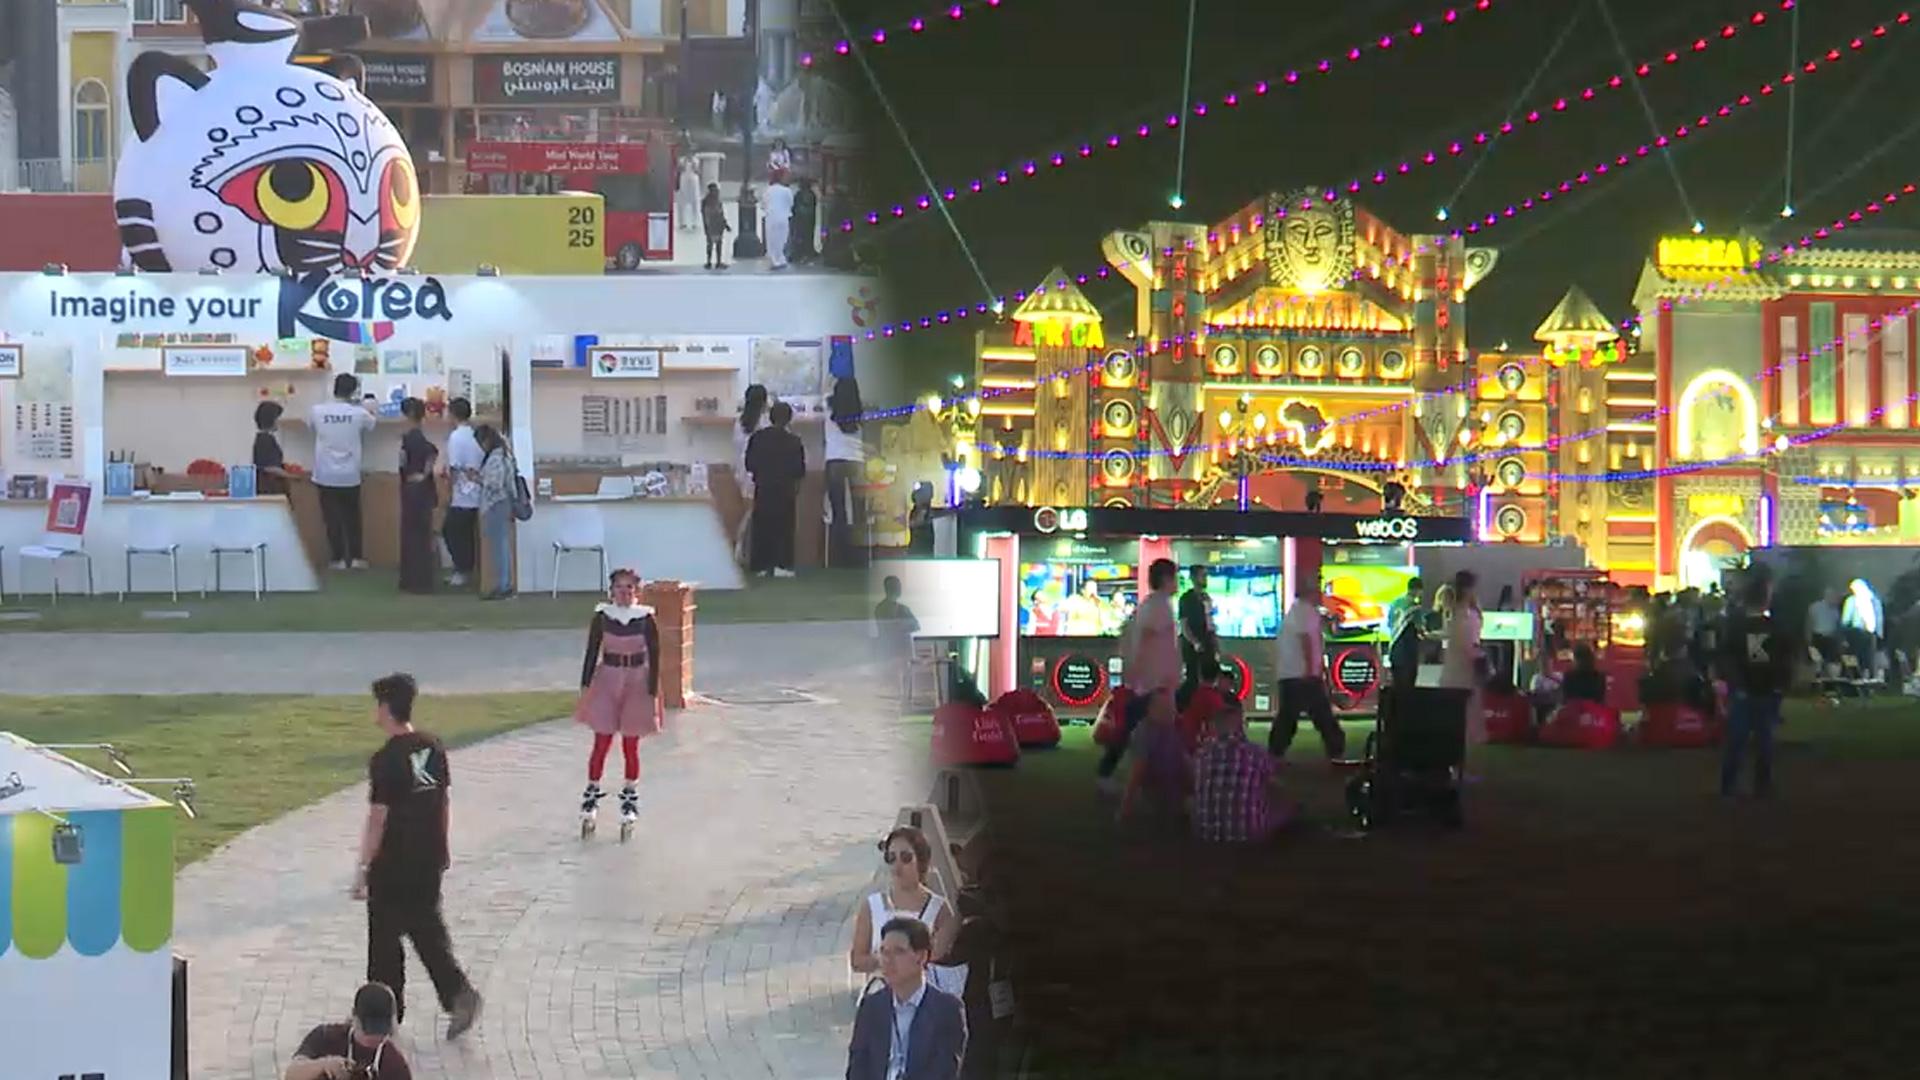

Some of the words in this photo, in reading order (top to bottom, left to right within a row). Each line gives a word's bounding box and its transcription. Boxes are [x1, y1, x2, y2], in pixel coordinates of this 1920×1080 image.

[569, 61, 614, 75] HOUSE
[568, 206, 595, 225] 20
[568, 229, 595, 248] 25
[51, 291, 176, 324] Imagine
[186, 297, 262, 325] your
[278, 268, 453, 345] Korea
[1013, 317, 1105, 349] AFRICA
[1060, 508, 1088, 531] LG
[1356, 517, 1418, 538] webOS
